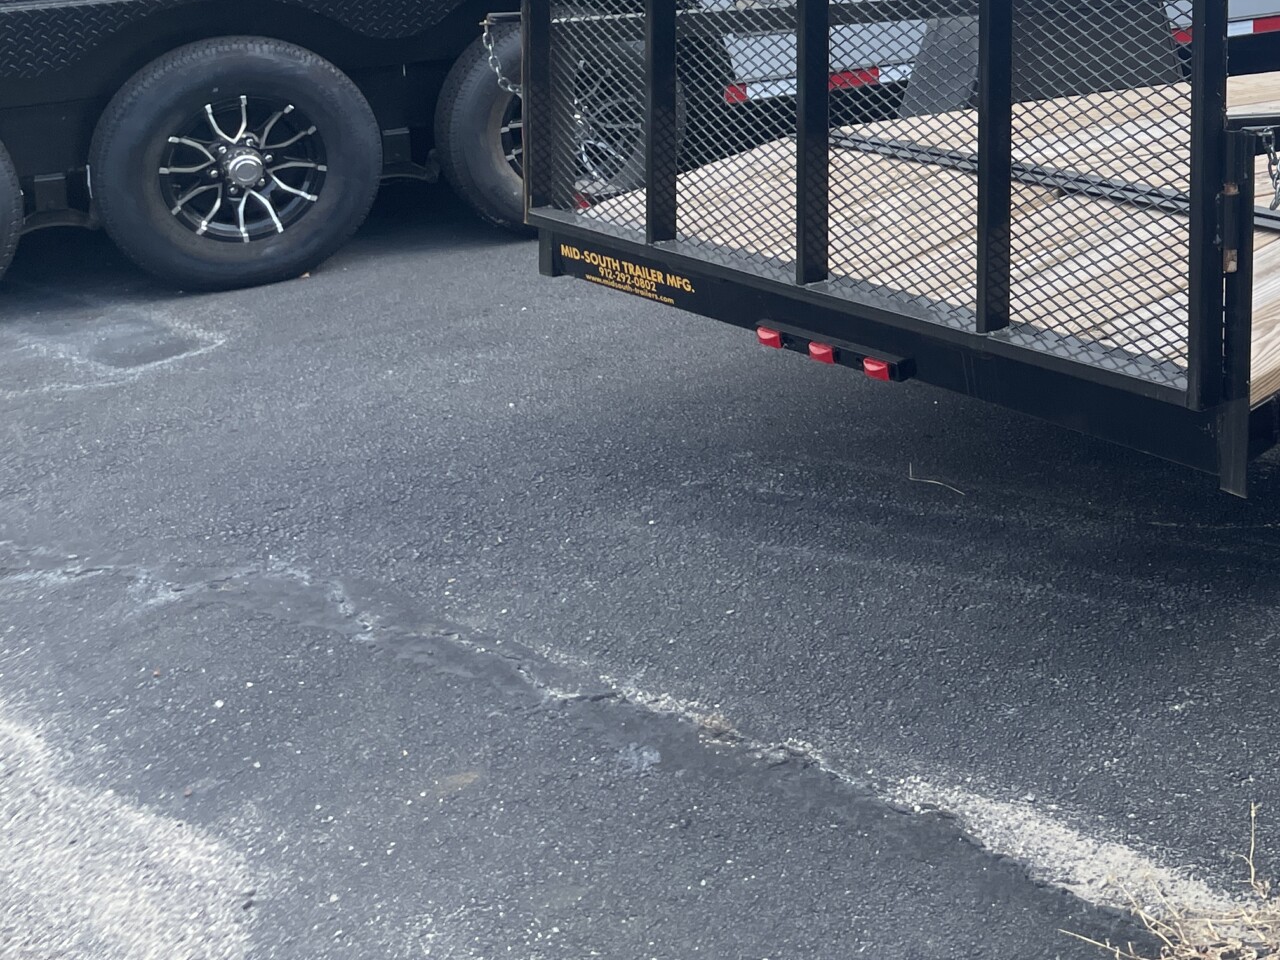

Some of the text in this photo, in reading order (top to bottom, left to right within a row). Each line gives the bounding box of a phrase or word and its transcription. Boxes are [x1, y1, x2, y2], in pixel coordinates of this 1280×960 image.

[560, 244, 696, 293] MID-SOUTH TRAILER MFG.
[598, 266, 657, 292] 912-292-0802
[585, 273, 675, 305] www.midsouth-trailers.com
